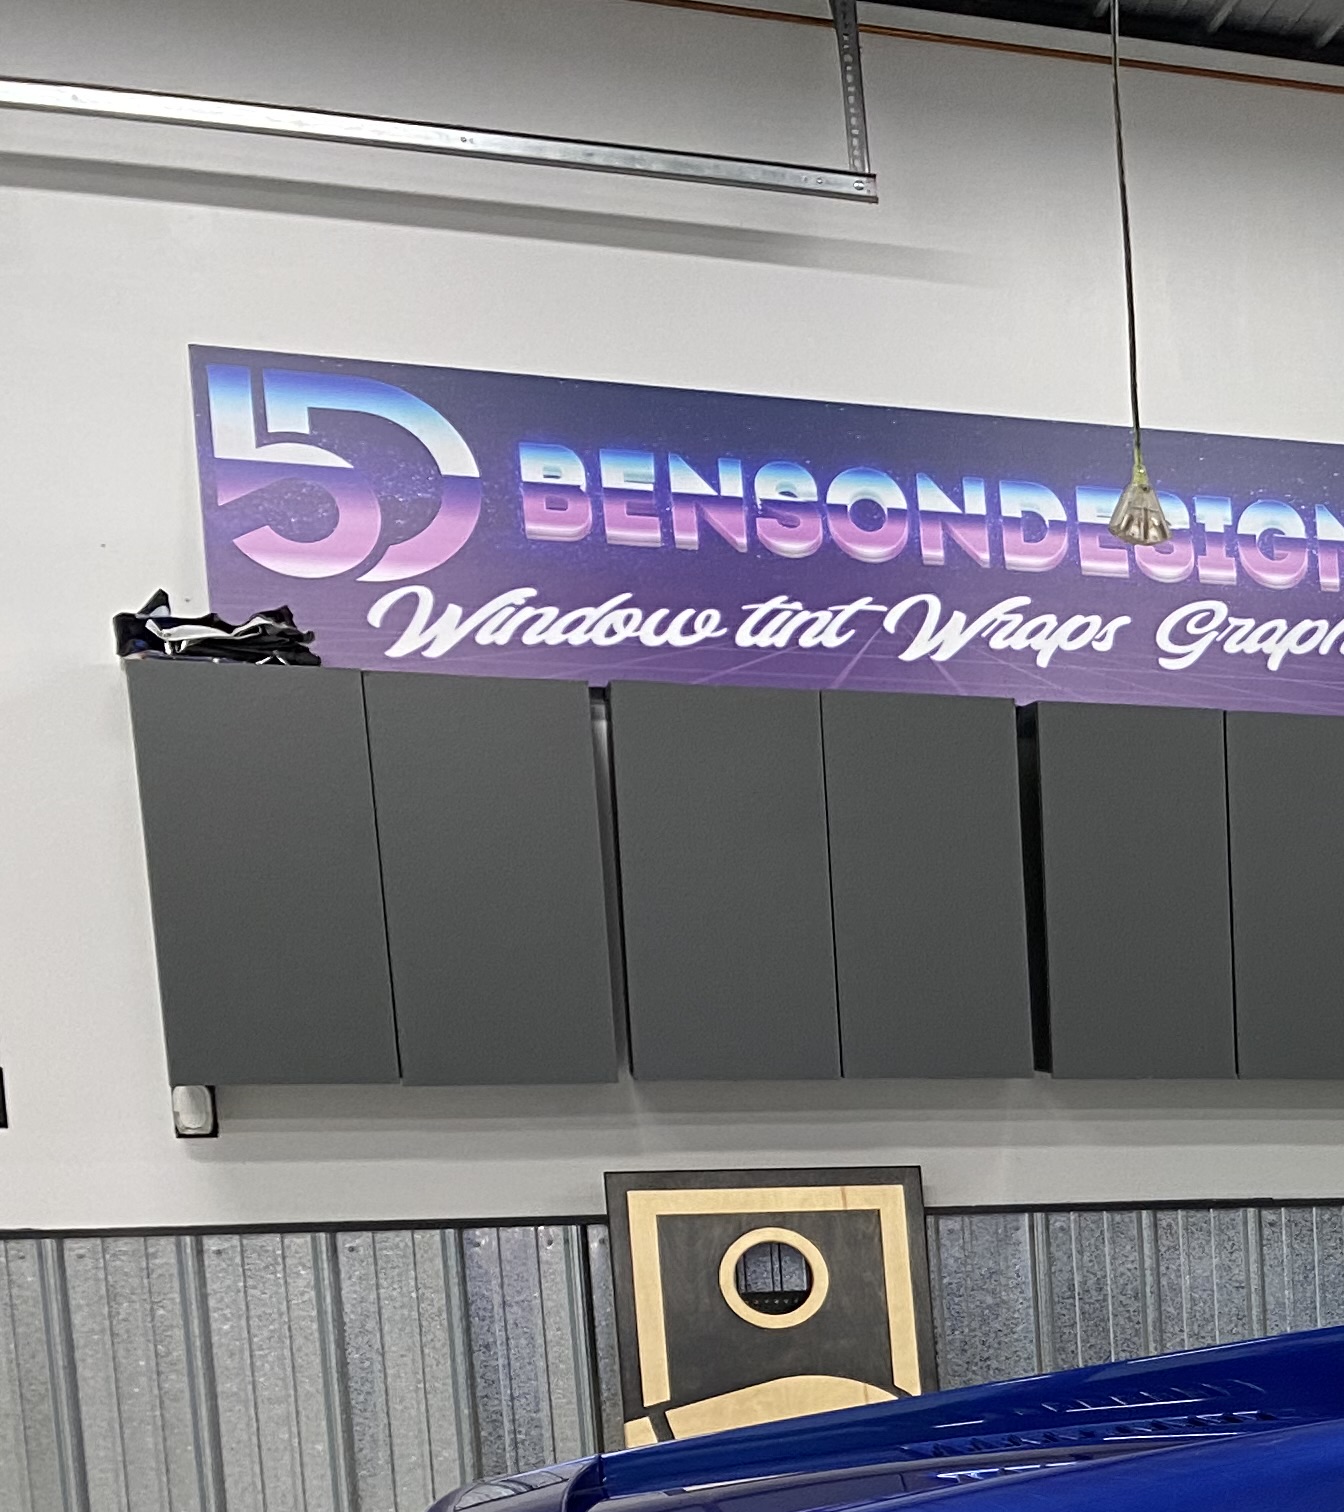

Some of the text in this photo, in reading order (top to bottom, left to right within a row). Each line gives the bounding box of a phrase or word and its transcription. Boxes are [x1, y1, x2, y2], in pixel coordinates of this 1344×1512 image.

[366, 584, 728, 658] Window
[736, 594, 888, 650] tint
[882, 592, 1133, 669] Wraps
